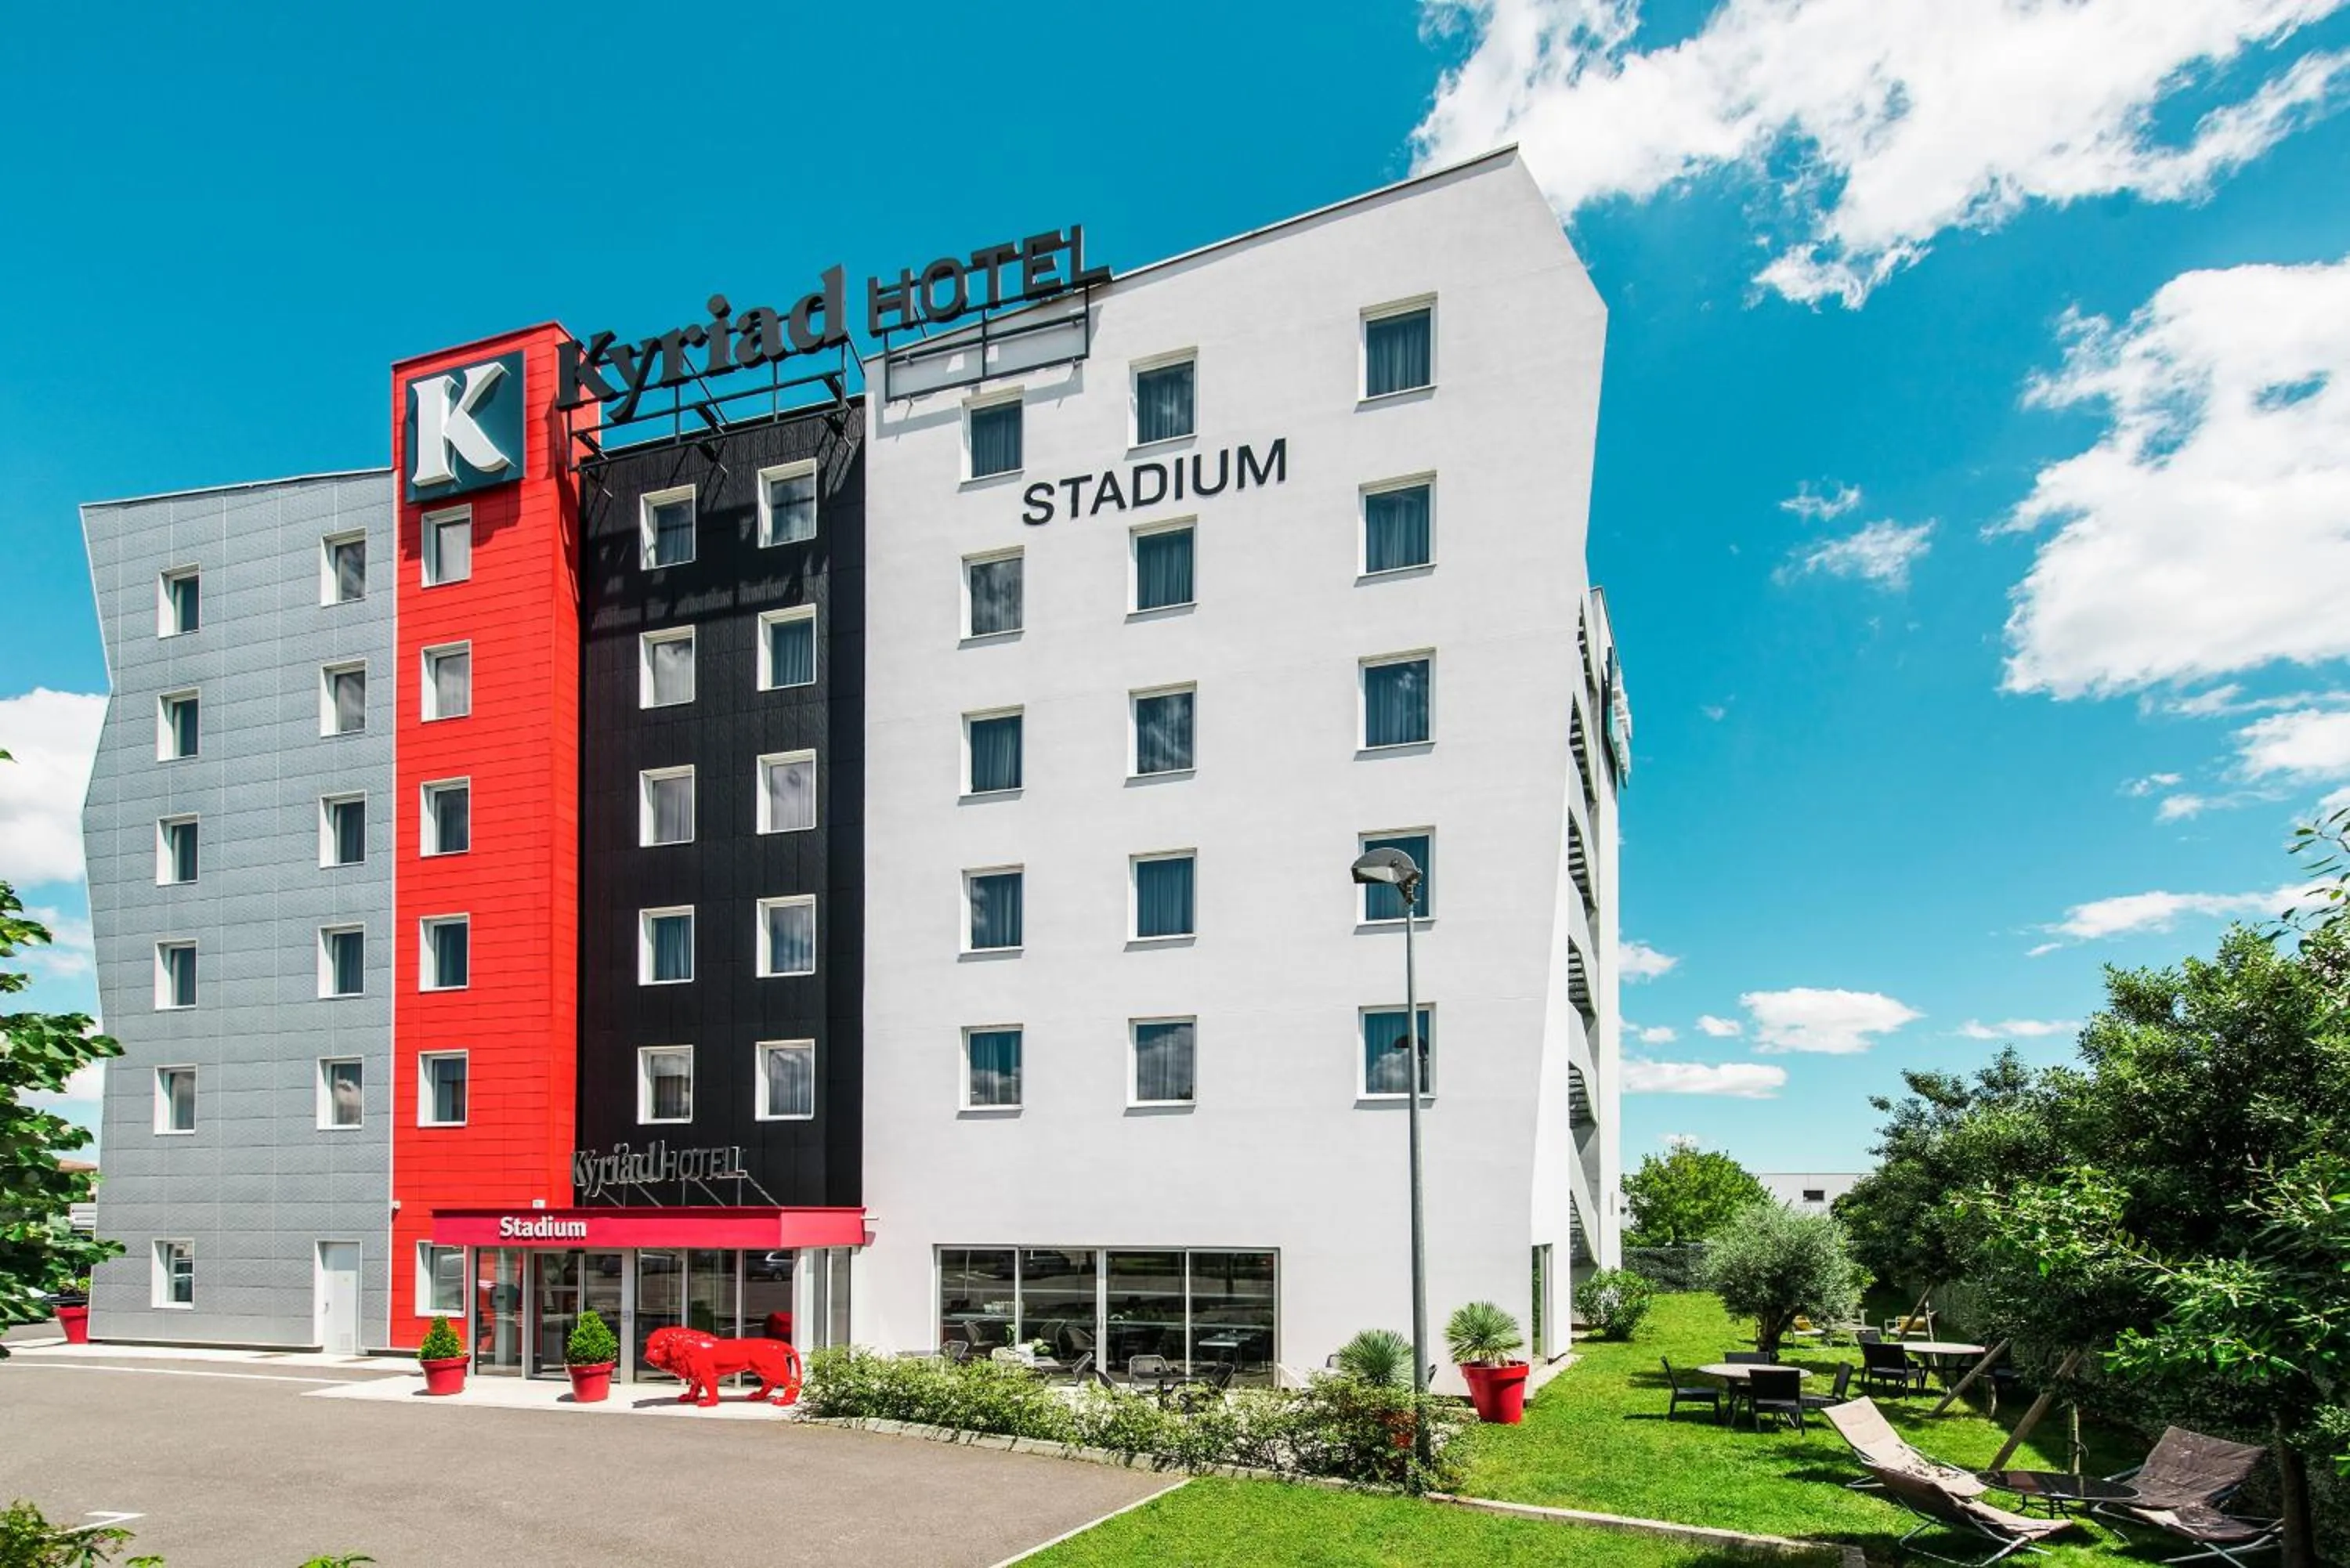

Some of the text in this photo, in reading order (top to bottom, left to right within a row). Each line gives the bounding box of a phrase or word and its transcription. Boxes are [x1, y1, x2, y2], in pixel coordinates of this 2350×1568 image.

[555, 224, 1112, 424] Kyriad HOTEL
[411, 362, 516, 487] K
[1022, 437, 1286, 526] STADIUM
[573, 1140, 747, 1198] Kyriad HOTEL
[499, 1216, 587, 1239] Stadium
